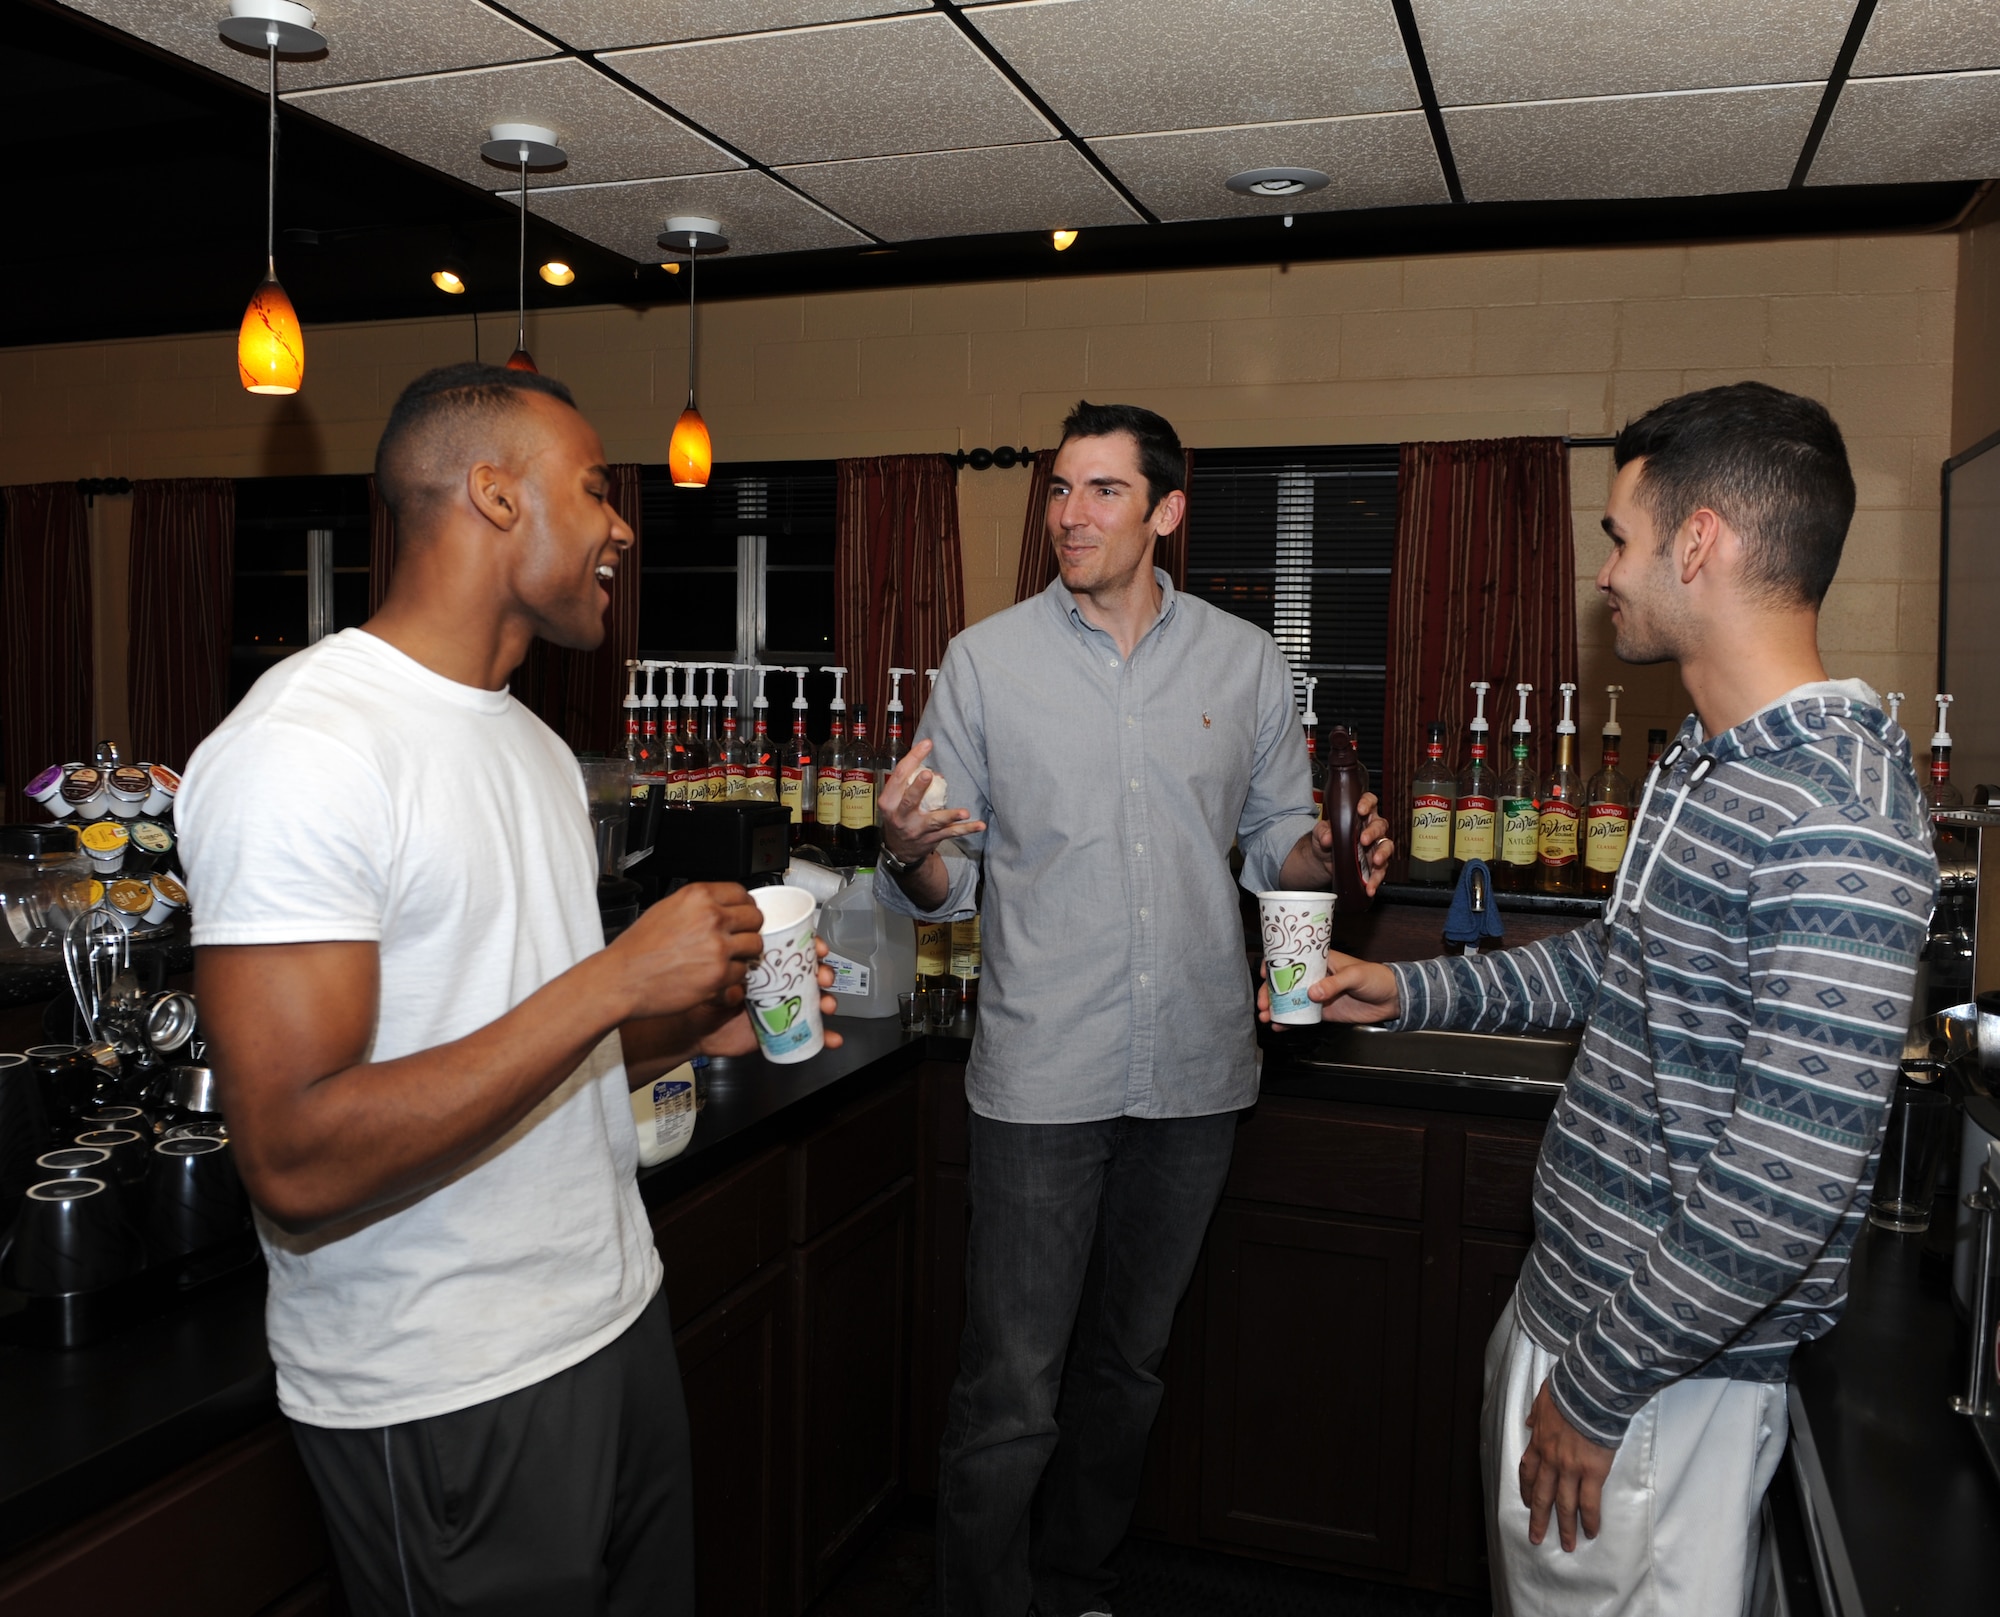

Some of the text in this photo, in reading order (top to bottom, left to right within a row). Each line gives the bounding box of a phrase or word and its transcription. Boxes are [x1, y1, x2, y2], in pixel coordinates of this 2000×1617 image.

[754, 769, 772, 777] Agave
[782, 770, 792, 778] erry
[842, 784, 872, 800] DaVinci
[1427, 798, 1449, 809] Colada
[1467, 800, 1485, 808] Lime
[1596, 807, 1622, 817] Mango
[1412, 812, 1448, 829] DaVinci
[1457, 814, 1493, 831] DaVinci
[1539, 819, 1575, 838] DaVinci
[1588, 822, 1627, 839] DaVinci
